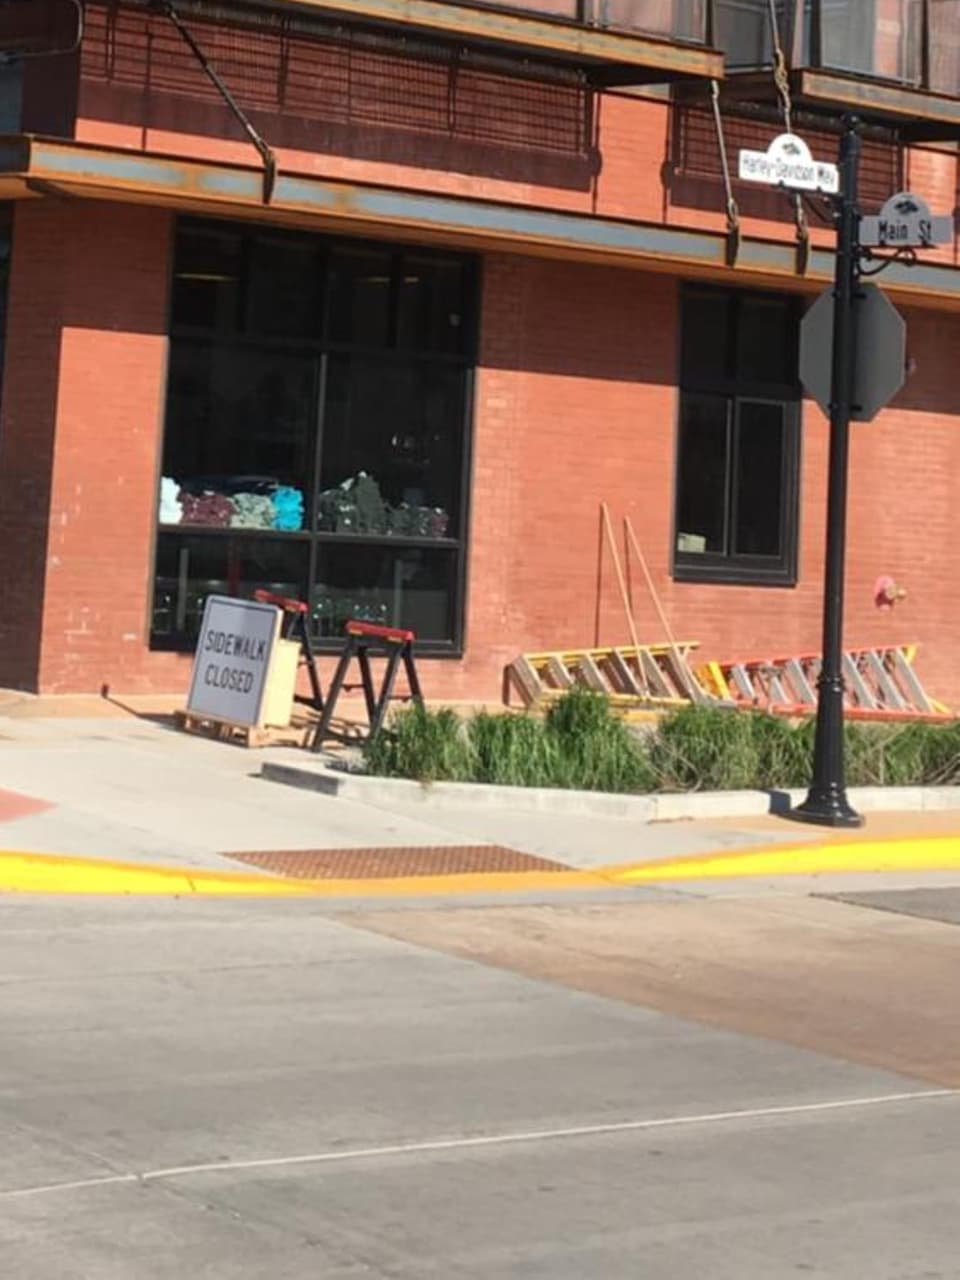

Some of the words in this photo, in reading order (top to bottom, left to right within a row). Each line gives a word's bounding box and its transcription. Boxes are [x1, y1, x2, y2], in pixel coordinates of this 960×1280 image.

[878, 220, 909, 241] Main
[918, 219, 933, 241] St
[204, 629, 267, 661] SIDEWALK
[204, 664, 254, 694] CLOSED
